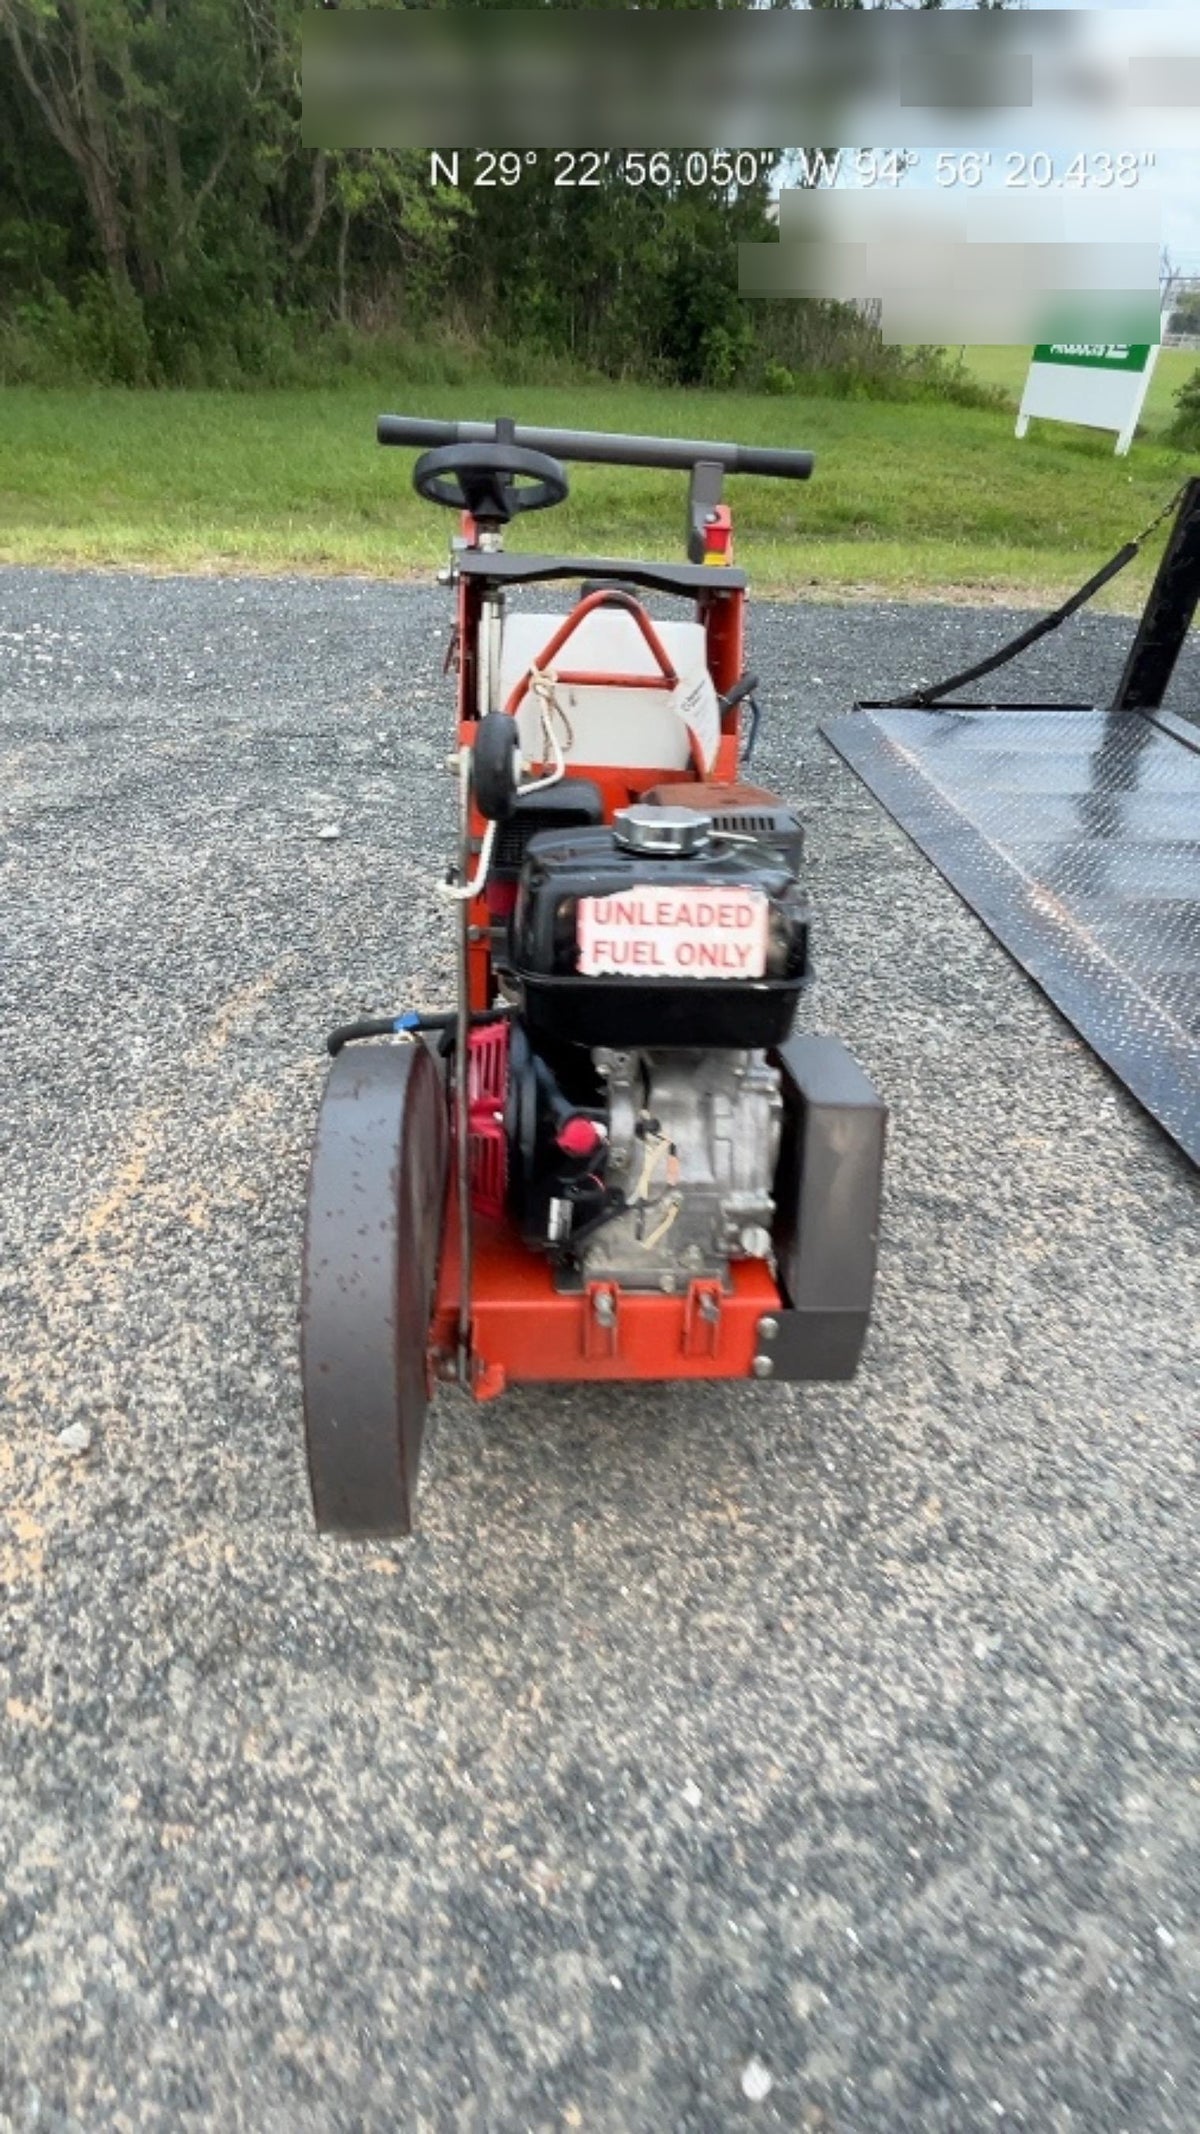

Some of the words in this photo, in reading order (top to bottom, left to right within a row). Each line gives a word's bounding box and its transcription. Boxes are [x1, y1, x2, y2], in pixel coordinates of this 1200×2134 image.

[593, 900, 754, 928] UNLEADED
[592, 941, 664, 965] FUEL
[674, 943, 752, 968] ONLY
